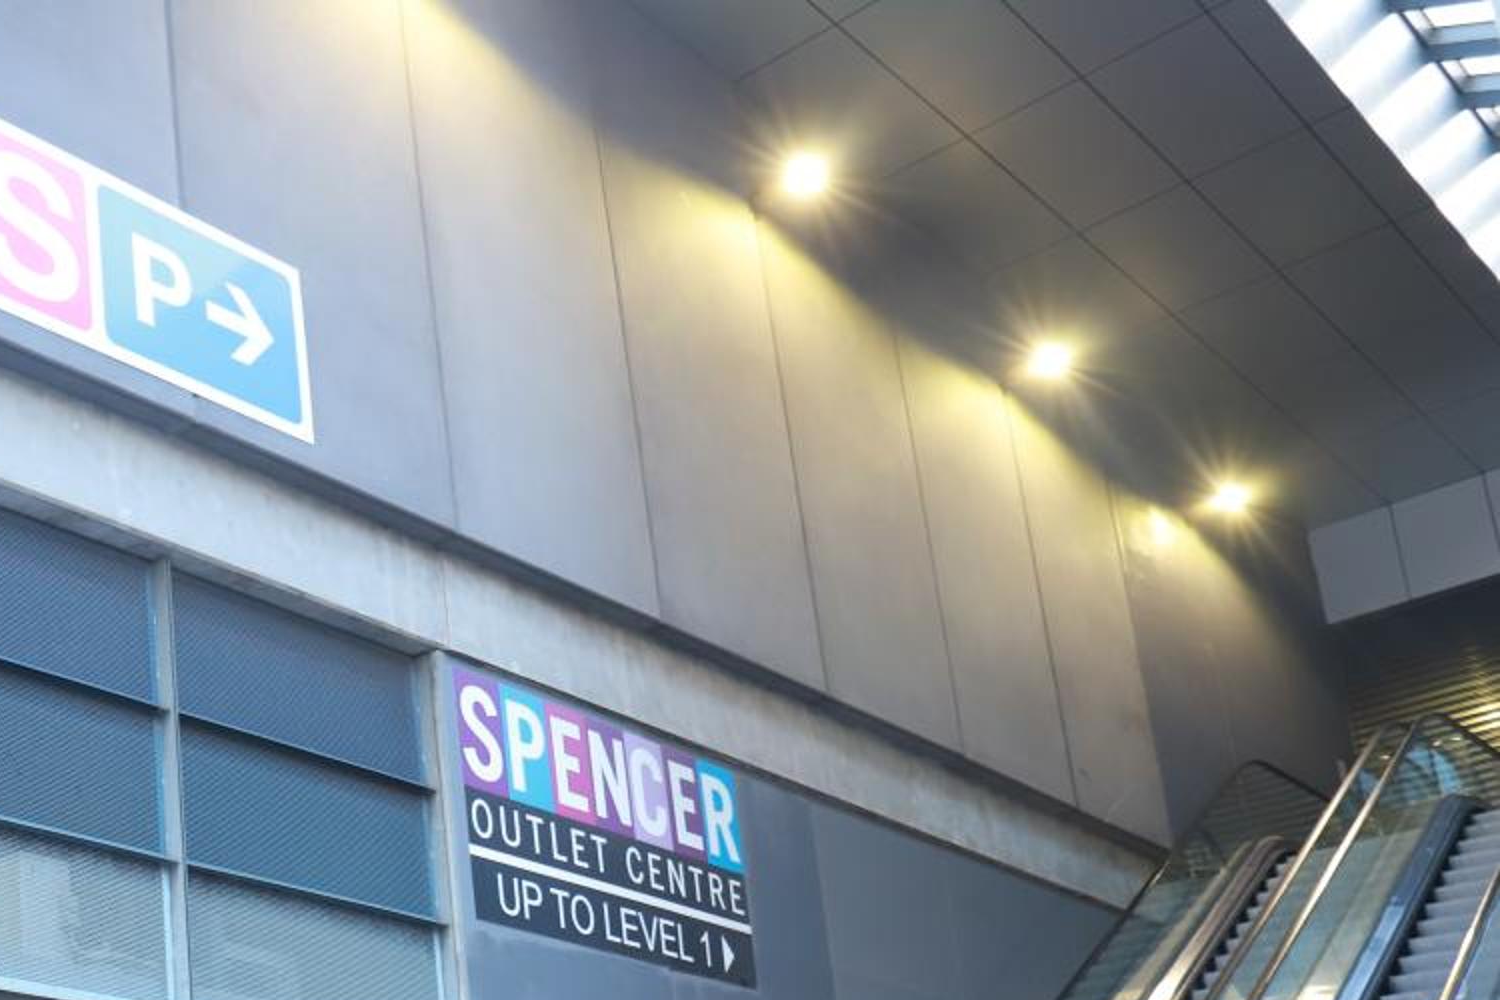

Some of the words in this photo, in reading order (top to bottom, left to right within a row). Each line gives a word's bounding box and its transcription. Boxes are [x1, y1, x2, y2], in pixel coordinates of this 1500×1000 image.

[130, 231, 193, 328] P
[458, 684, 741, 865] SPENCER
[470, 797, 608, 875] OUTLET
[625, 846, 746, 917] CENTRE
[497, 872, 544, 921] UP
[549, 887, 595, 936] TO
[602, 901, 695, 963] LEVEL
[700, 930, 712, 968] 1
